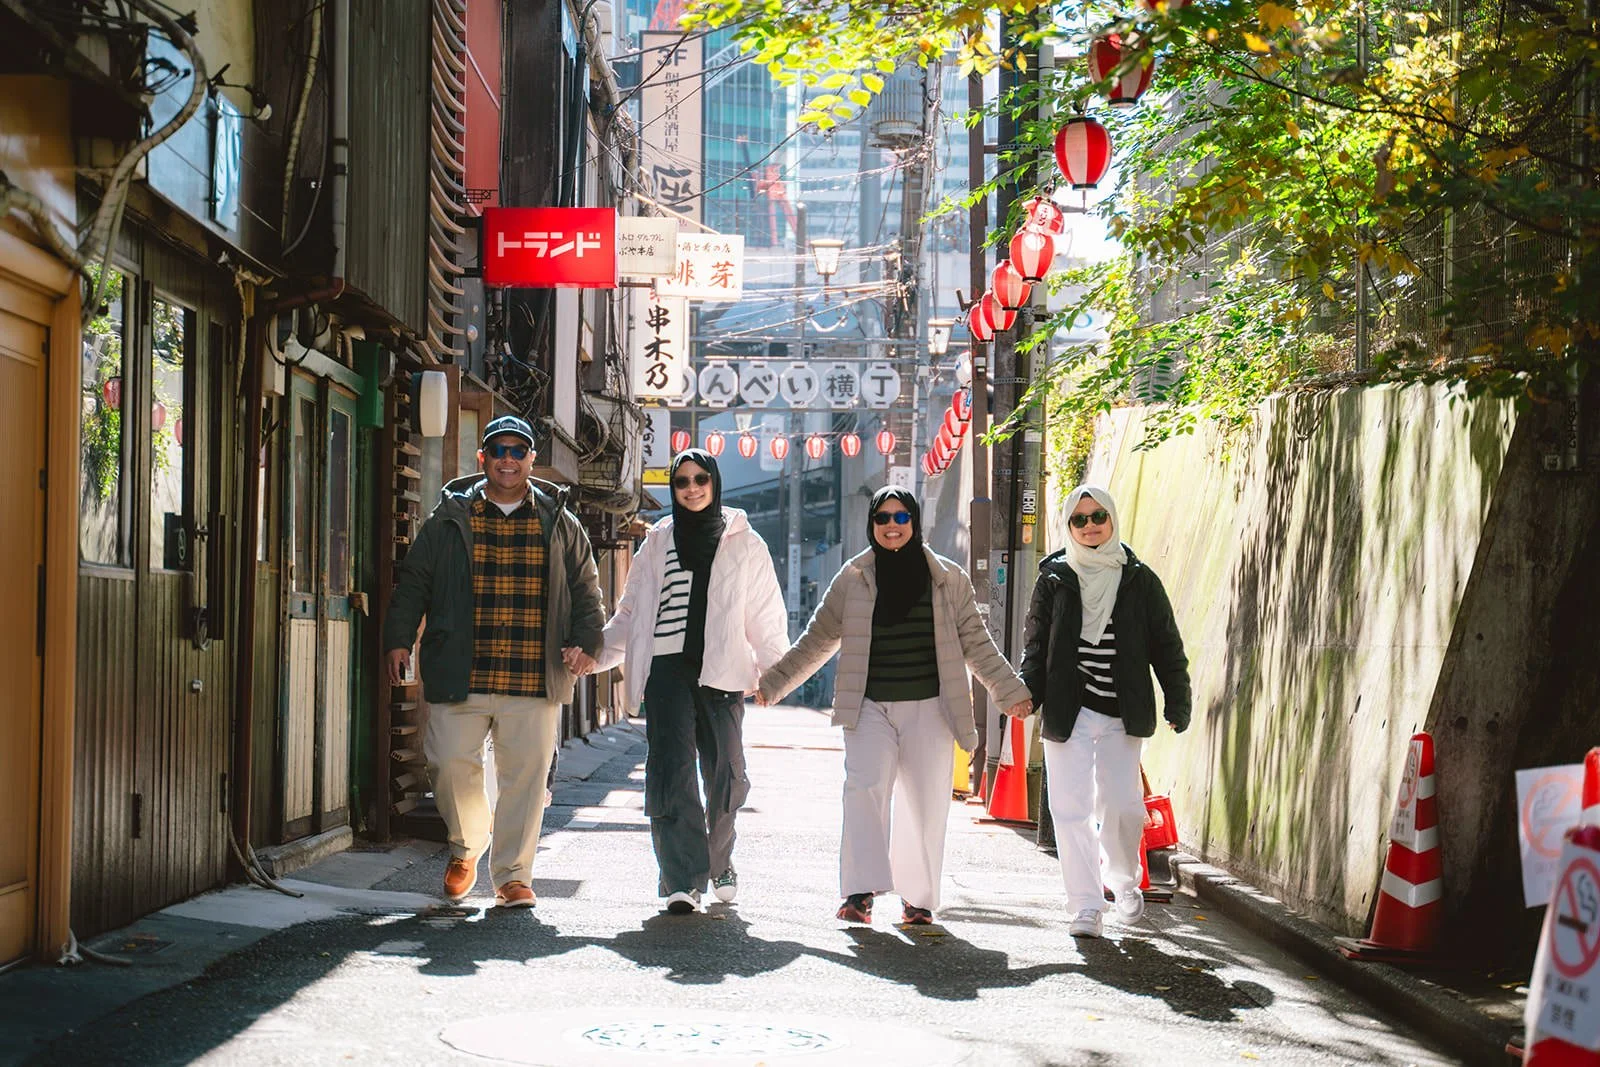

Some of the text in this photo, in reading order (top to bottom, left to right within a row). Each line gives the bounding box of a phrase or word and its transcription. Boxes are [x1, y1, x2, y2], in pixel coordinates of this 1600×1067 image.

[657, 49, 688, 67] 3F
[497, 232, 601, 258] トランド
[618, 233, 635, 241] トロ
[644, 305, 674, 390] 串木乃
[682, 373, 894, 398] んべい横丁
